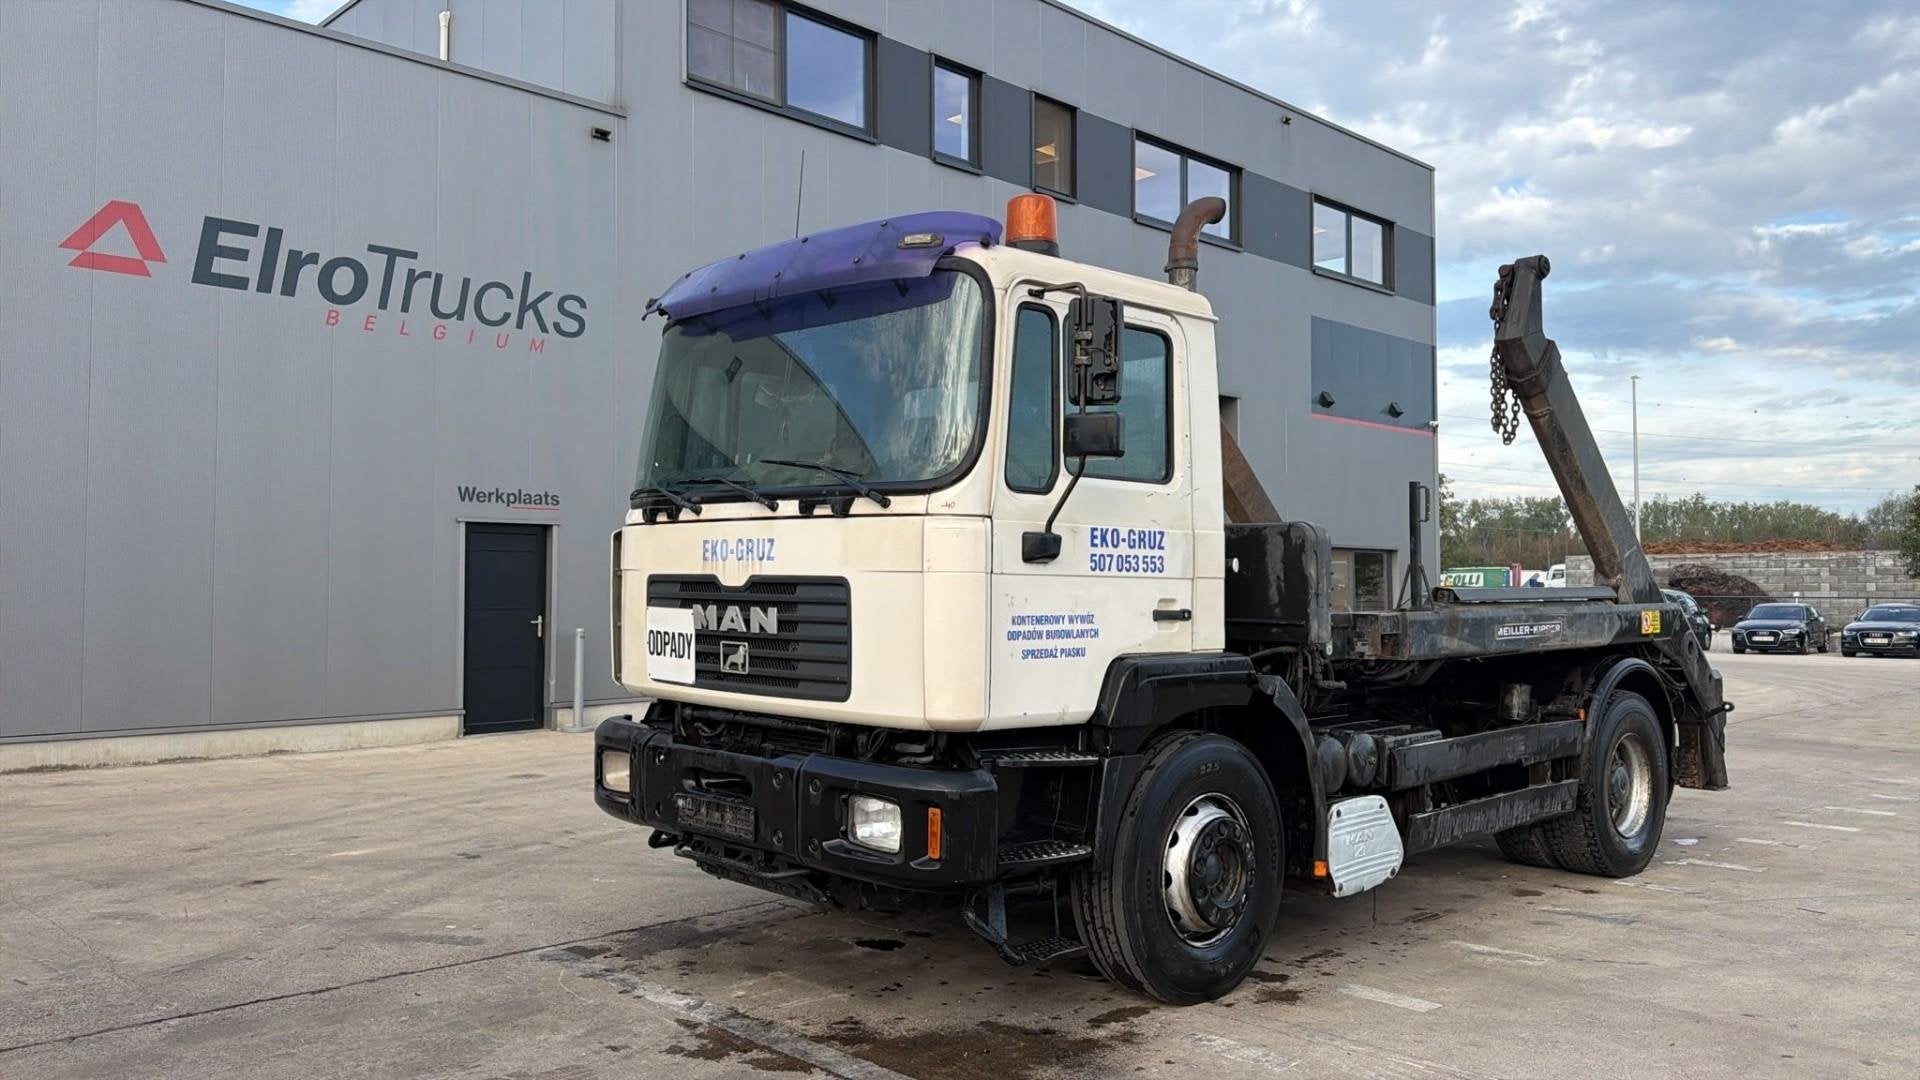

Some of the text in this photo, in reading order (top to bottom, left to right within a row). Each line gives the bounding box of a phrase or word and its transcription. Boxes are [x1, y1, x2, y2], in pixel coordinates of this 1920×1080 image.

[191, 215, 588, 339] ElroTrucks
[325, 309, 547, 354] BELGIUM
[457, 486, 560, 507] Werkplaats
[702, 538, 775, 562] EKO-GRUZ
[1089, 527, 1166, 550] EKO-GRUZ
[1089, 554, 1165, 574] 507 053 553
[692, 603, 779, 635] MAN
[1011, 611, 1095, 626] KONTENEROWY WYWÓZ
[648, 628, 693, 660] ODPADY
[1006, 627, 1099, 641] ODPADÓW BUDOWLANYCH
[1059, 646, 1086, 658] PIASKU
